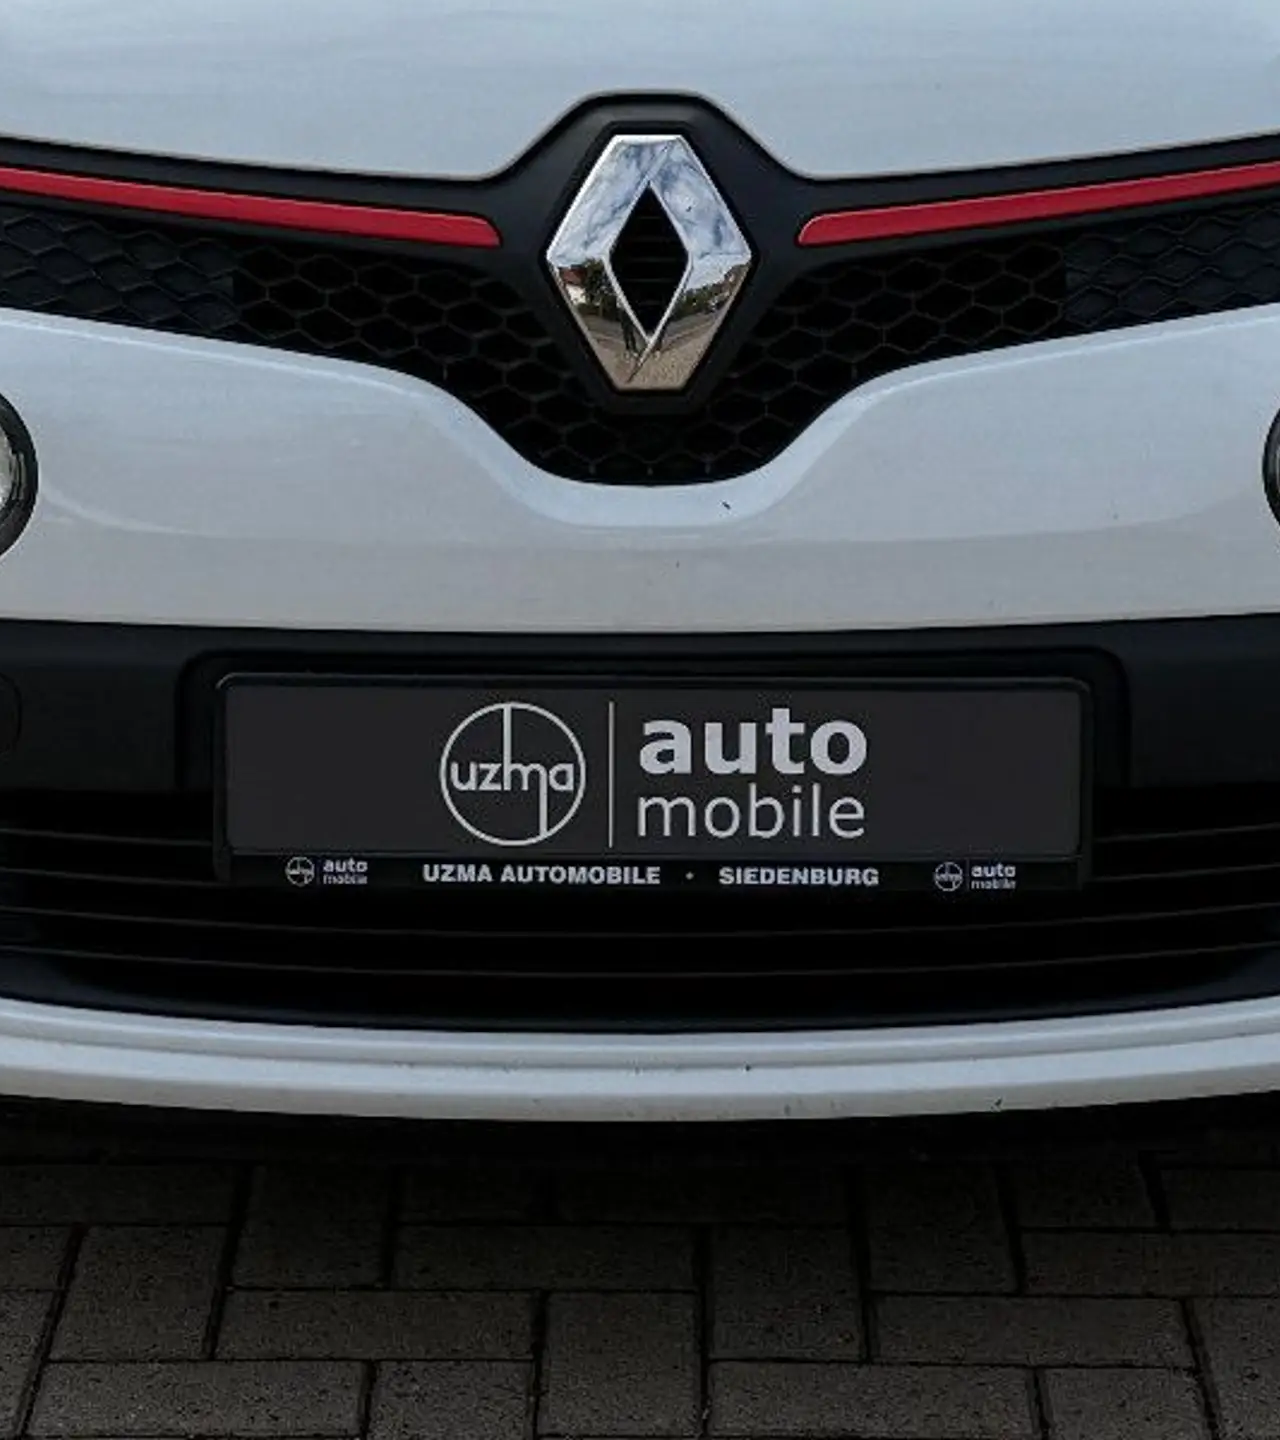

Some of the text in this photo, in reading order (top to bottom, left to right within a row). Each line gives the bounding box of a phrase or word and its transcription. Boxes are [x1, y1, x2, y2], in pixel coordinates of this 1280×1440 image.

[638, 707, 867, 775] auto
[638, 783, 865, 839] mobile
[323, 857, 368, 872] auto
[422, 864, 880, 886] UZMA AUTOMOBILE SIEDENBURG
[971, 863, 1016, 877] auto
